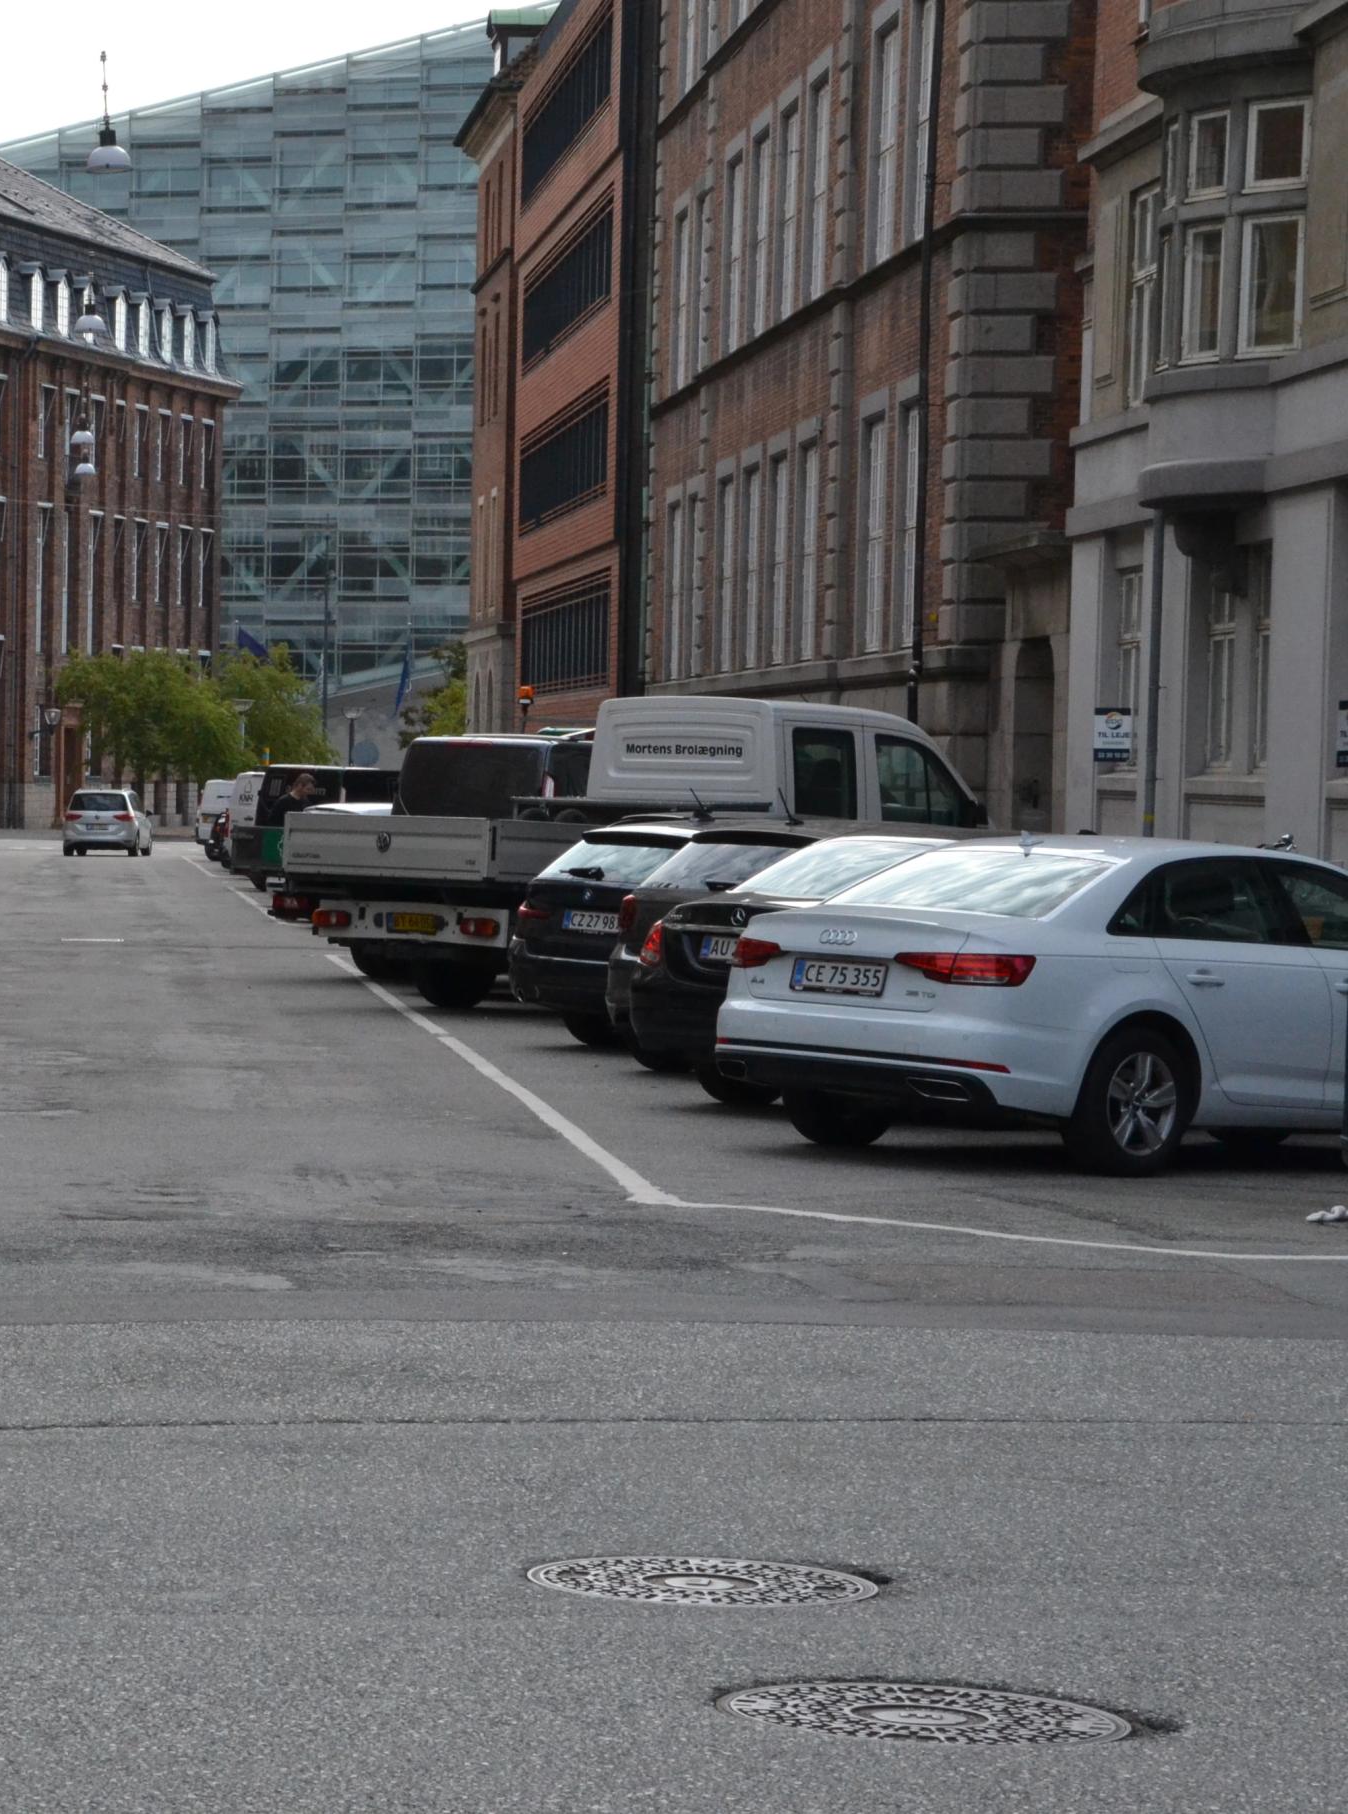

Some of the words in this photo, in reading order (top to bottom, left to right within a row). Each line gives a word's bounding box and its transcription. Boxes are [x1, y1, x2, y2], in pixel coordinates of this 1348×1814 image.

[626, 743, 672, 755] Mortens
[675, 744, 743, 758] Brolægning
[571, 913, 585, 927] CZ
[587, 915, 600, 928] 27
[710, 939, 727, 956] AU
[805, 963, 824, 983] CE
[829, 966, 847, 985] 75
[851, 967, 882, 987] 355
